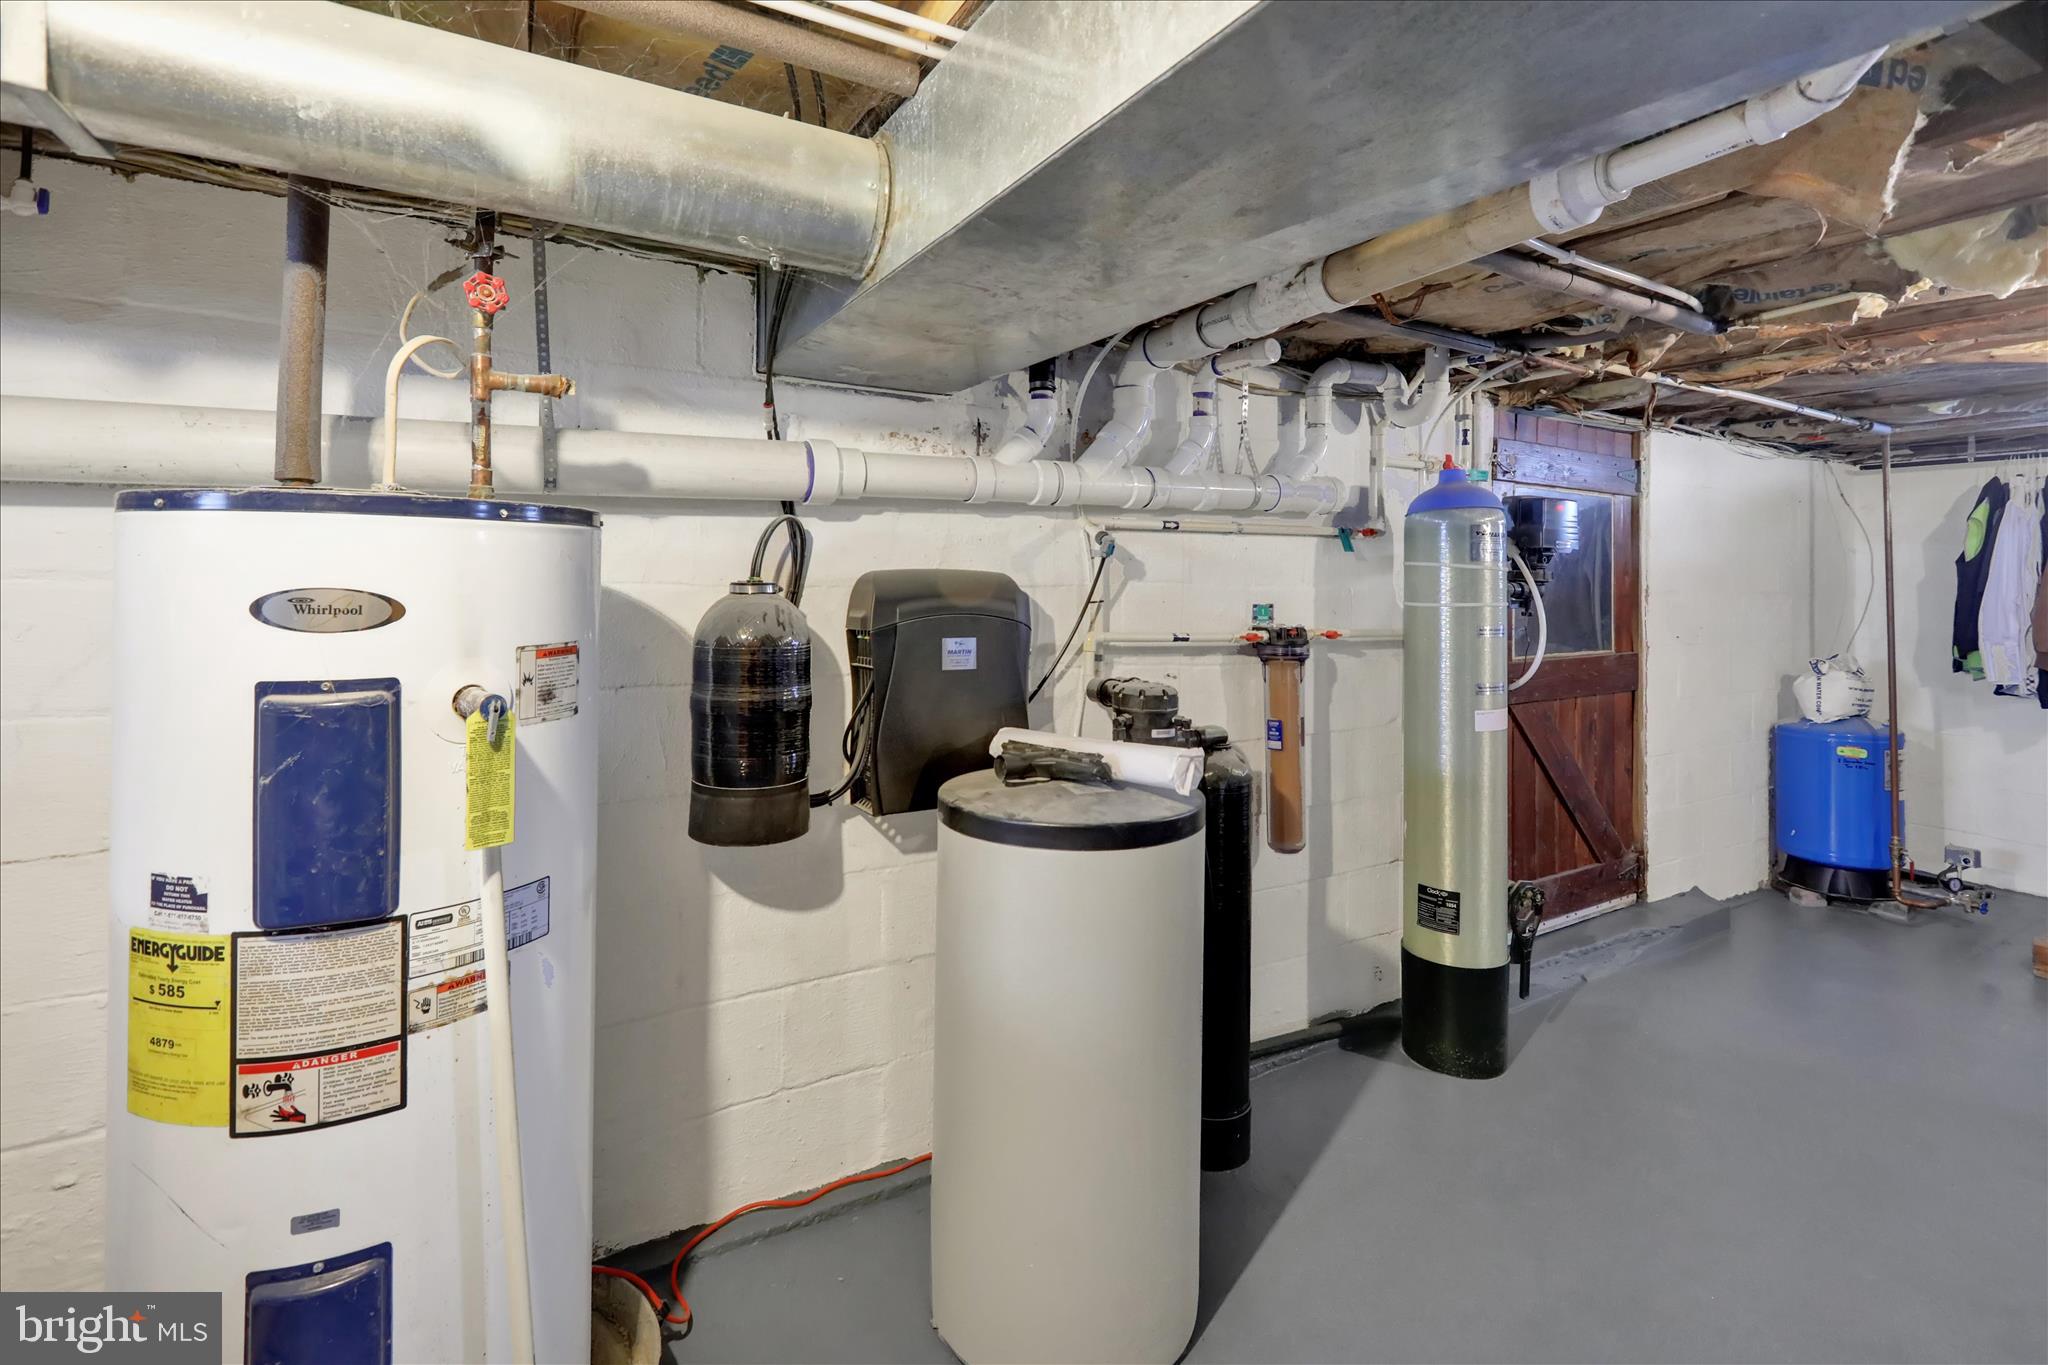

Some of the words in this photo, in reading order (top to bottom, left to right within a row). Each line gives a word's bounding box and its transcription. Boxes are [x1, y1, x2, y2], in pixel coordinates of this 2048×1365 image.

[293, 604, 363, 618] Whirlpool
[131, 936, 225, 963] ENERGYGUIDE
[149, 984, 155, 995] $
[158, 983, 185, 998] 585
[149, 1036, 175, 1049] 4879
[301, 1052, 359, 1067] DANGER
